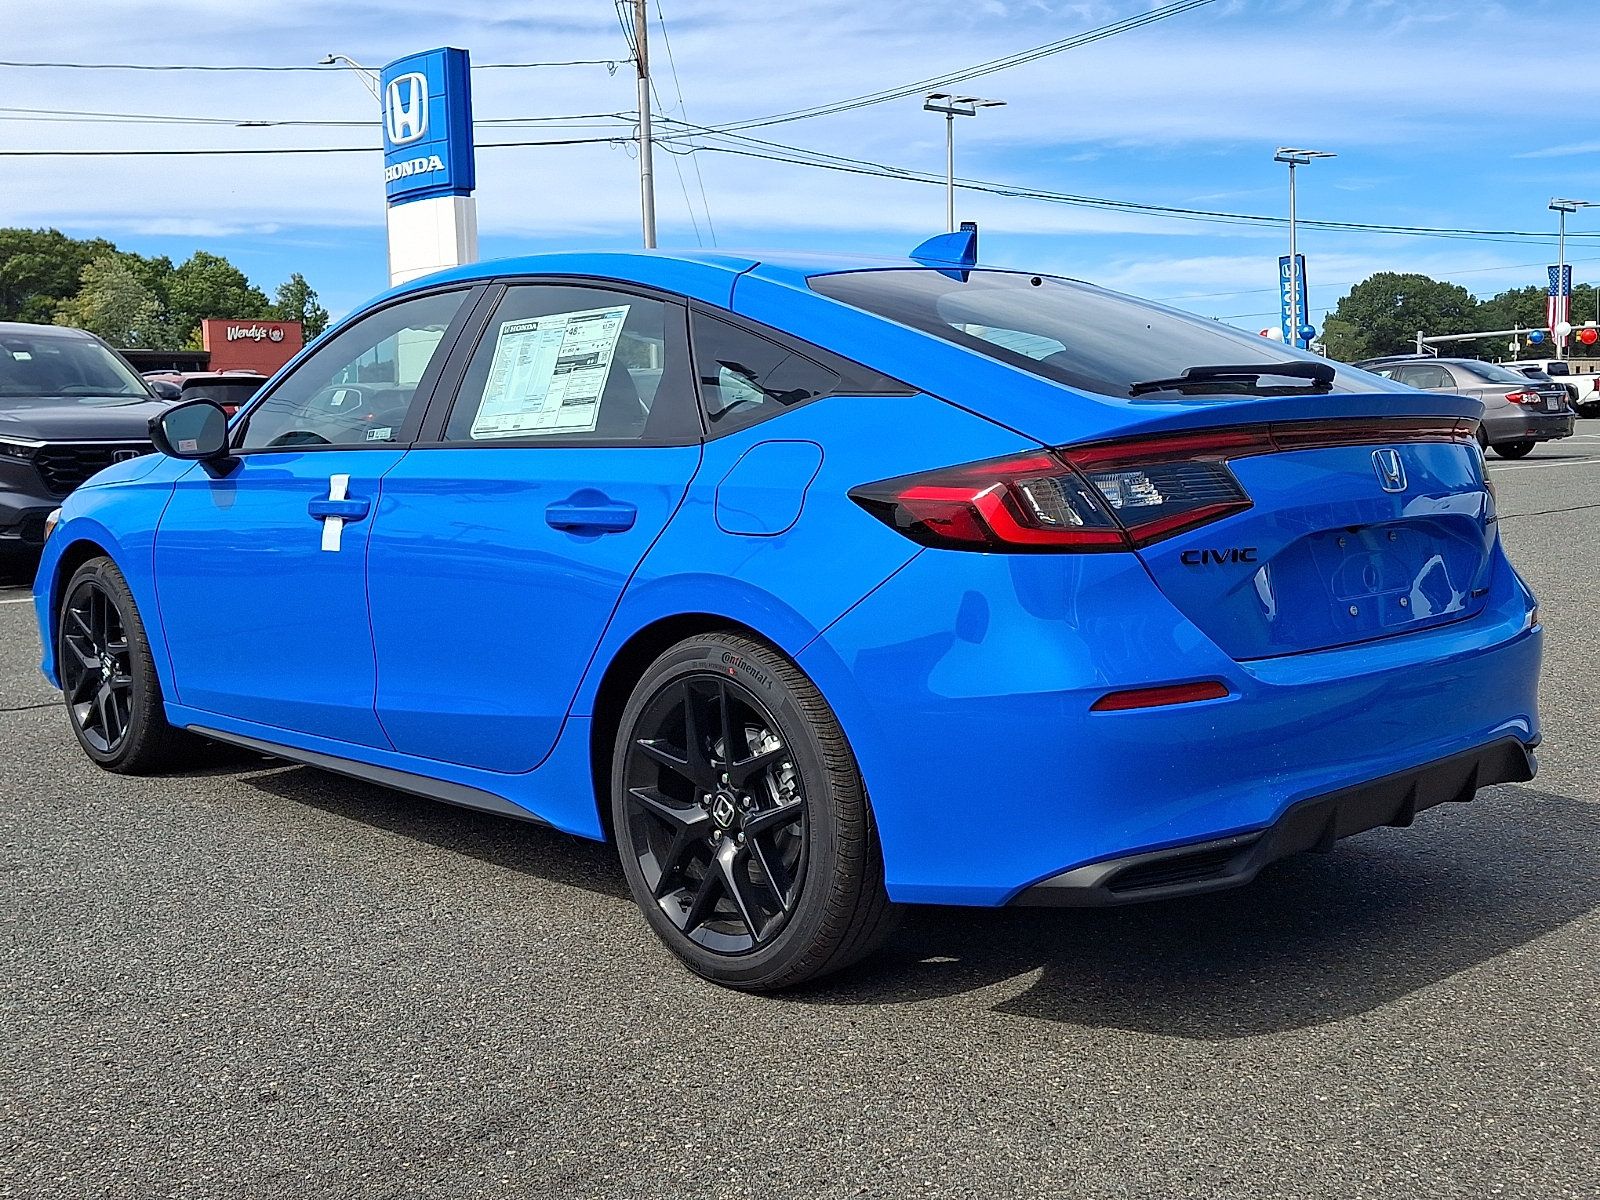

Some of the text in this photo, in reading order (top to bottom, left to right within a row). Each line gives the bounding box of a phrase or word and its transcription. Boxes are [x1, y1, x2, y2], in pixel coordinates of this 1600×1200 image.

[384, 154, 445, 181] HONDA
[227, 324, 267, 341] Wendy's
[1180, 547, 1258, 565] CIVIC
[721, 651, 770, 685] Continental
